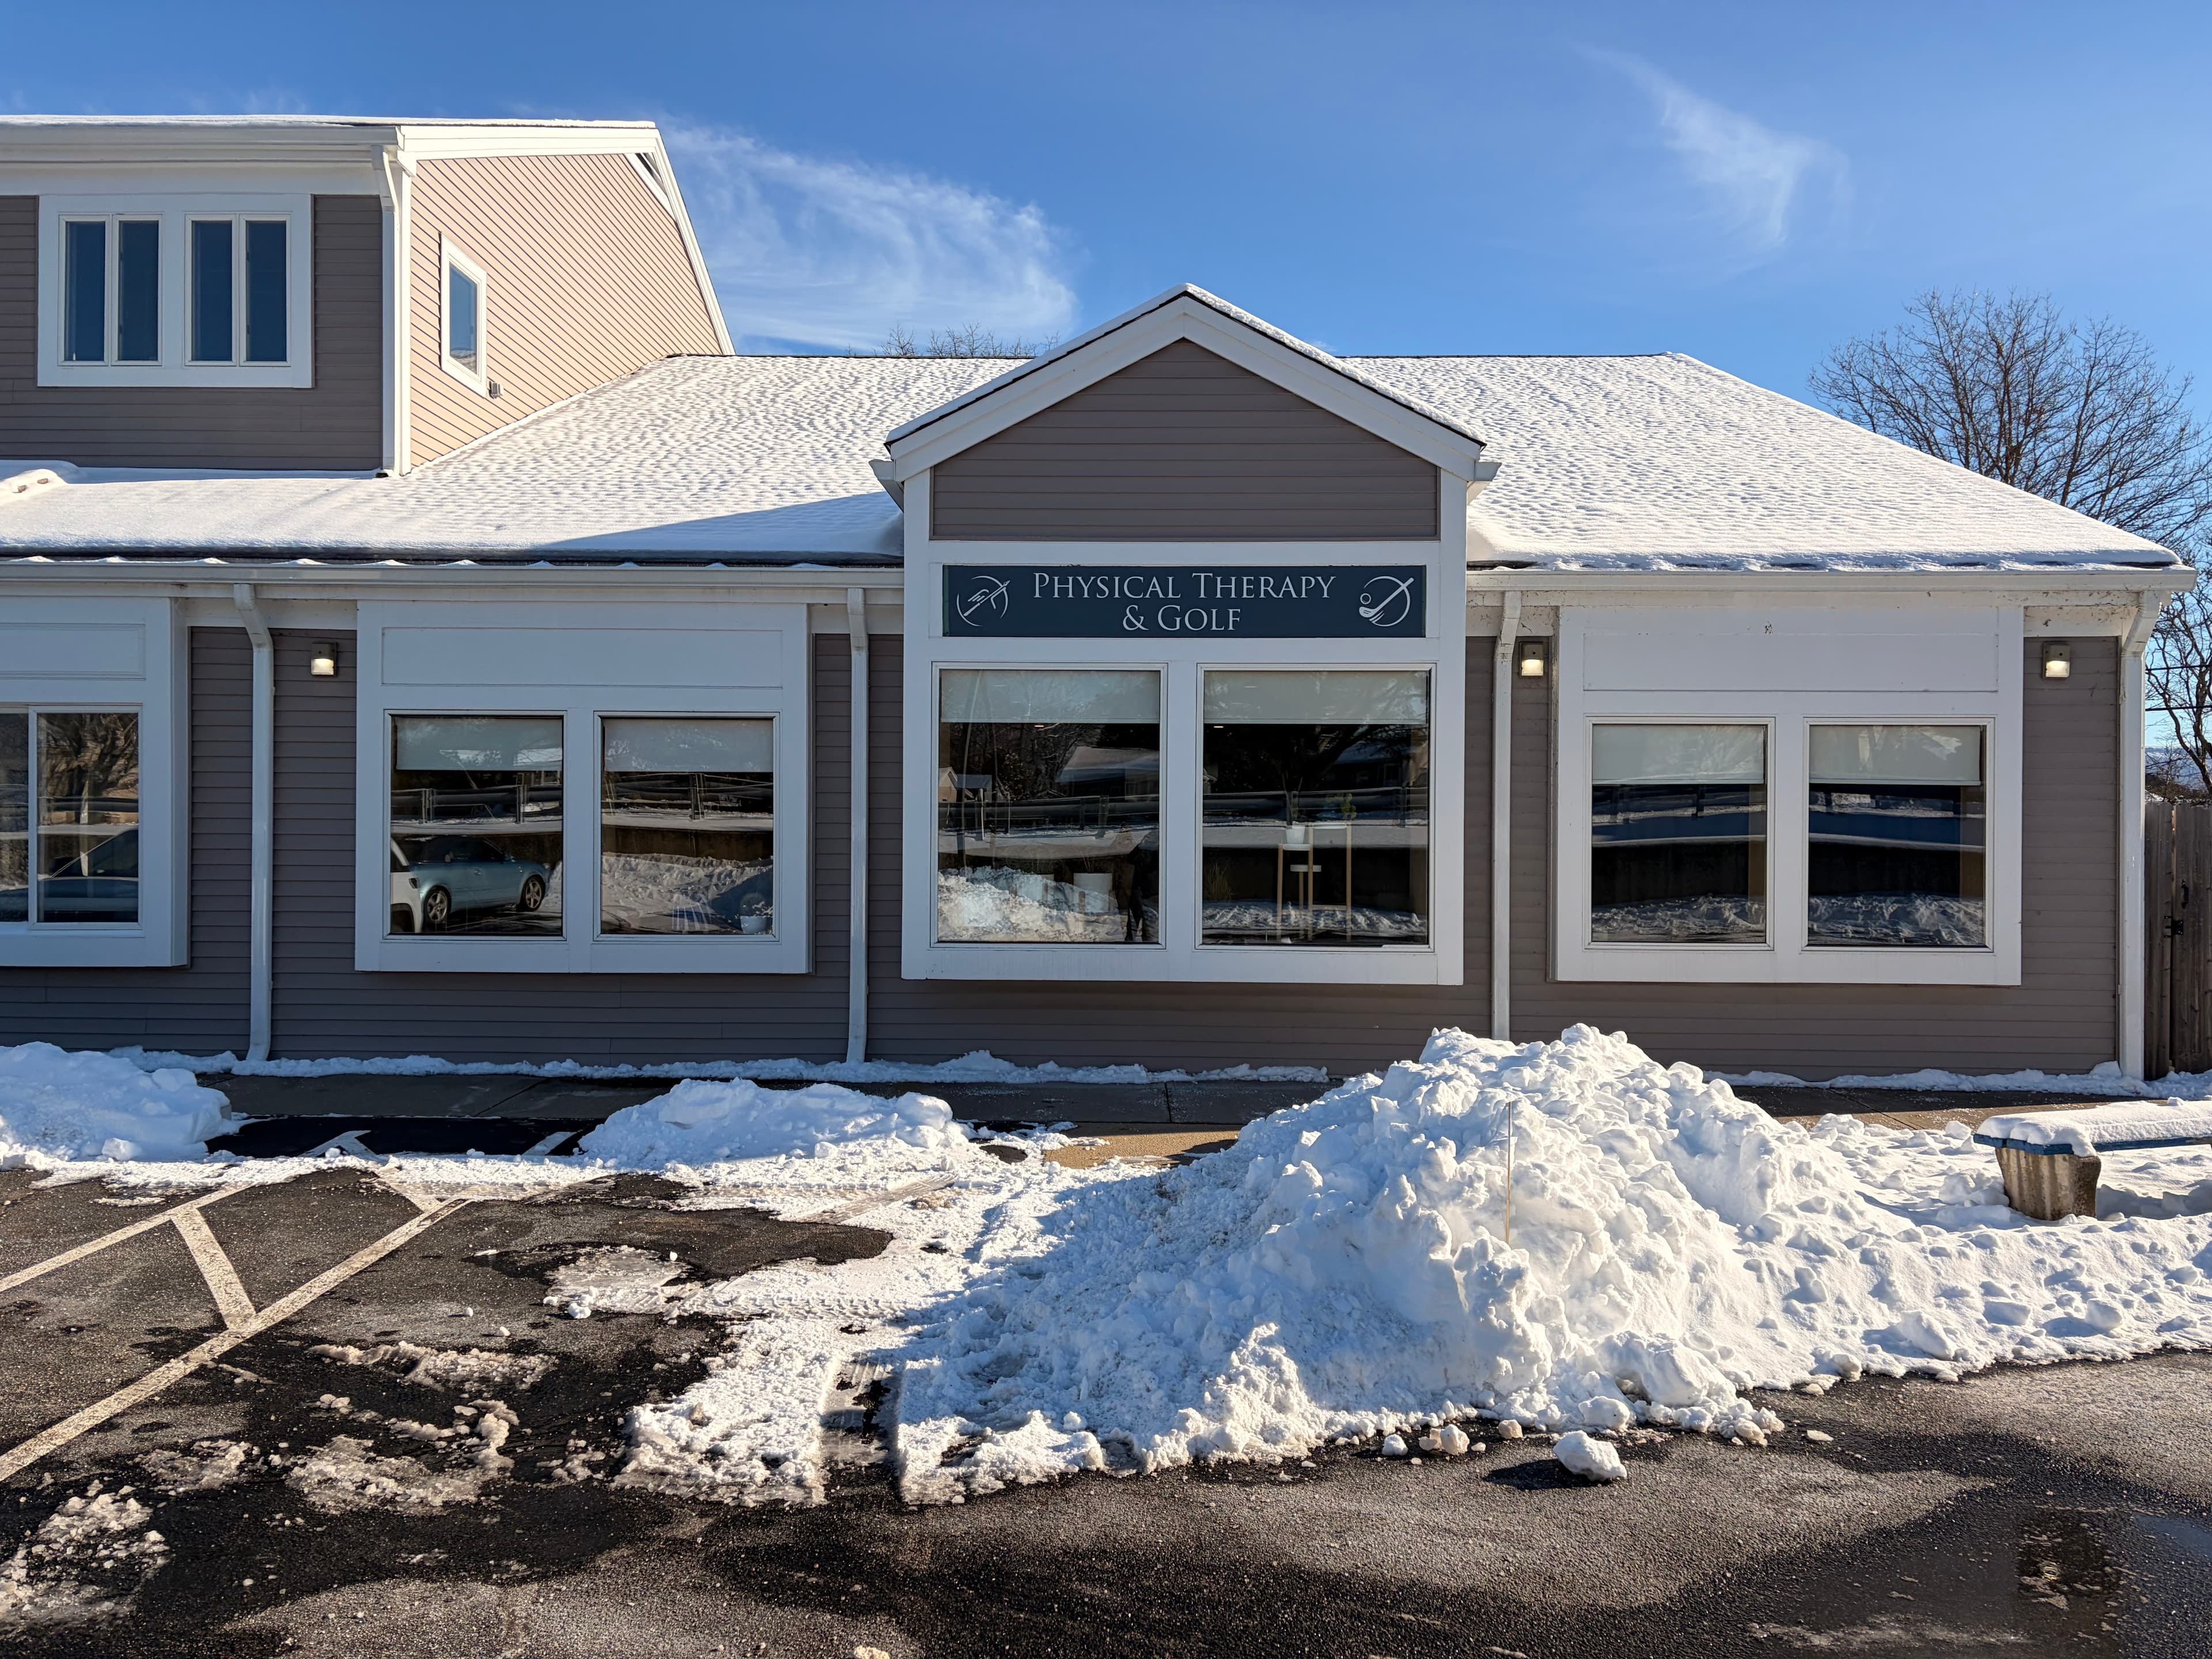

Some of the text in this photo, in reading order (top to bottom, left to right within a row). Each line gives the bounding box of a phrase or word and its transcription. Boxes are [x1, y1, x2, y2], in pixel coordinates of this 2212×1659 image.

[1033, 573, 1336, 599] PHYSICAL THERAPY
[1123, 605, 1241, 631] & GOLF
